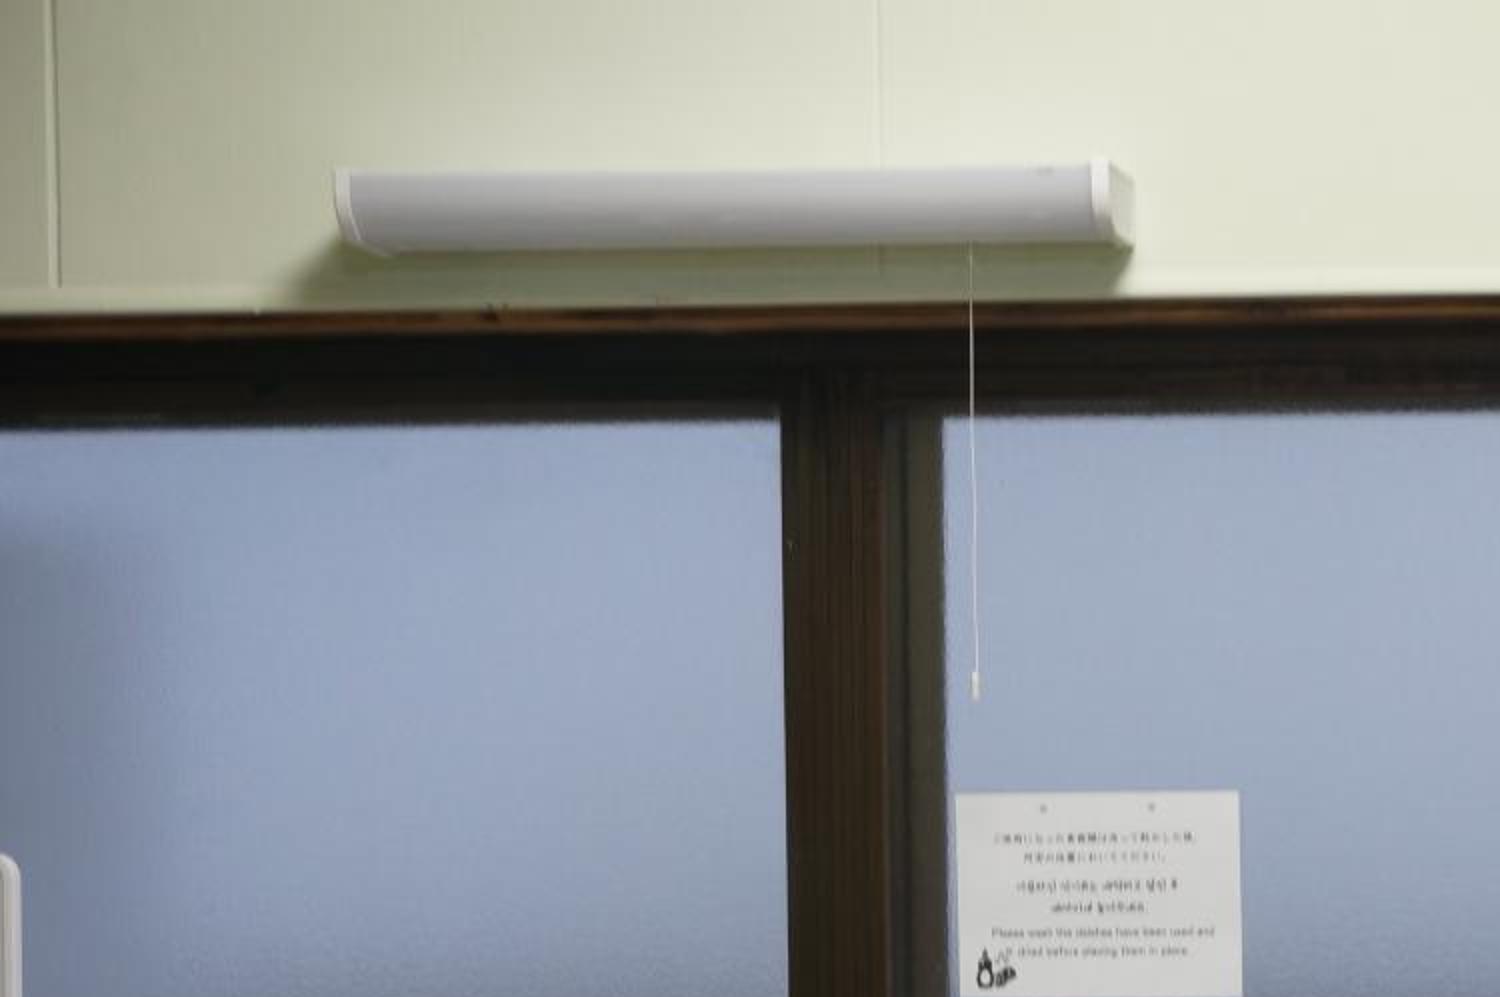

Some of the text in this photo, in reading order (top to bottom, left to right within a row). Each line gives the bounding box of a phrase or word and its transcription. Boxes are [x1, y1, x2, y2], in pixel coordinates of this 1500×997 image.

[991, 926, 1024, 939] Please
[1115, 926, 1139, 938] have
[1170, 925, 1194, 938] used
